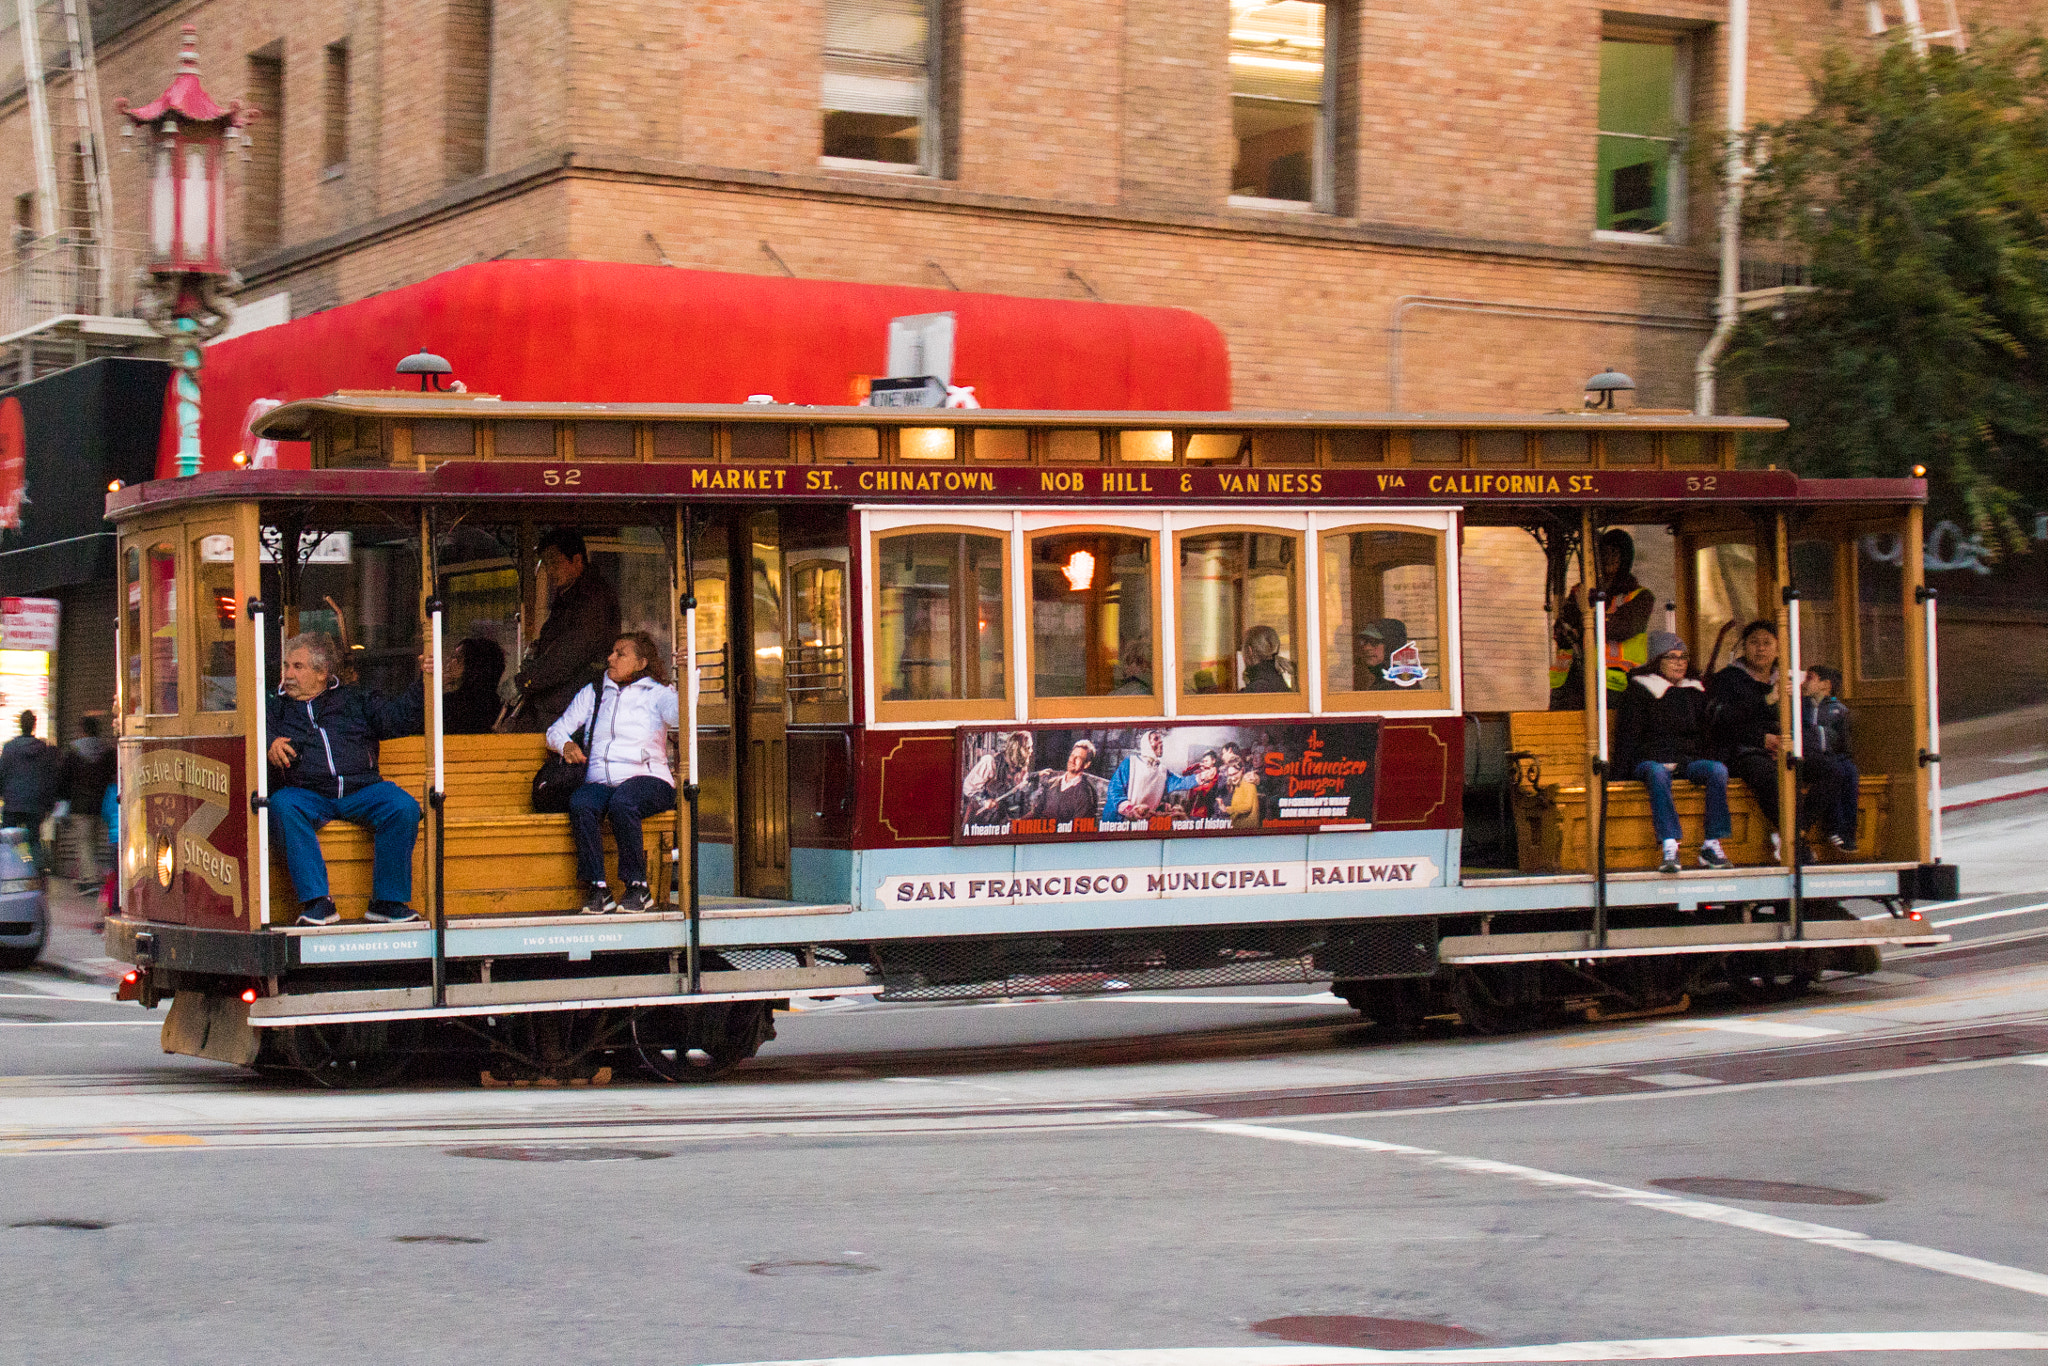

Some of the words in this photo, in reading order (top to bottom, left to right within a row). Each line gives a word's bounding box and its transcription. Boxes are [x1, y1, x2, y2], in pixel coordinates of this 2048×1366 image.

[543, 468, 582, 486] 52
[691, 469, 786, 489] MARKET
[806, 470, 839, 490] ST.
[859, 471, 994, 491] CHINATOWN
[1041, 472, 1085, 491] NOB
[1102, 473, 1153, 492] HILL
[1180, 473, 1193, 492] &
[1218, 474, 1260, 492] VAN
[1267, 474, 1322, 492] NESS
[1428, 475, 1561, 493] CALIFORNIA
[1568, 475, 1600, 493] ST.
[1686, 476, 1717, 491] 52
[1264, 751, 1300, 776] San
[1301, 750, 1368, 776] Francisco
[175, 757, 229, 795] Clifornia
[1288, 776, 1346, 797] Dungeon
[963, 824, 971, 837] A
[971, 823, 1000, 836] theatre
[1001, 822, 1011, 835] of
[1012, 818, 1057, 834] THRILLS
[1057, 820, 1073, 833] and
[1098, 819, 1130, 832] Interact
[1131, 819, 1149, 831] with
[1150, 816, 1172, 831] 200
[1172, 818, 1195, 831] years
[1195, 817, 1205, 829] of
[1204, 817, 1234, 830] history.
[184, 838, 233, 885] Streets
[897, 881, 956, 902] SAN
[968, 873, 1129, 899] FRANCISCO
[1147, 868, 1288, 892] MUNICIPAL
[1311, 863, 1418, 886] RAILWAY
[313, 944, 336, 952] TWO
[392, 940, 418, 949] ONLY
[523, 937, 545, 946] TWO
[598, 933, 623, 942] ONLY
